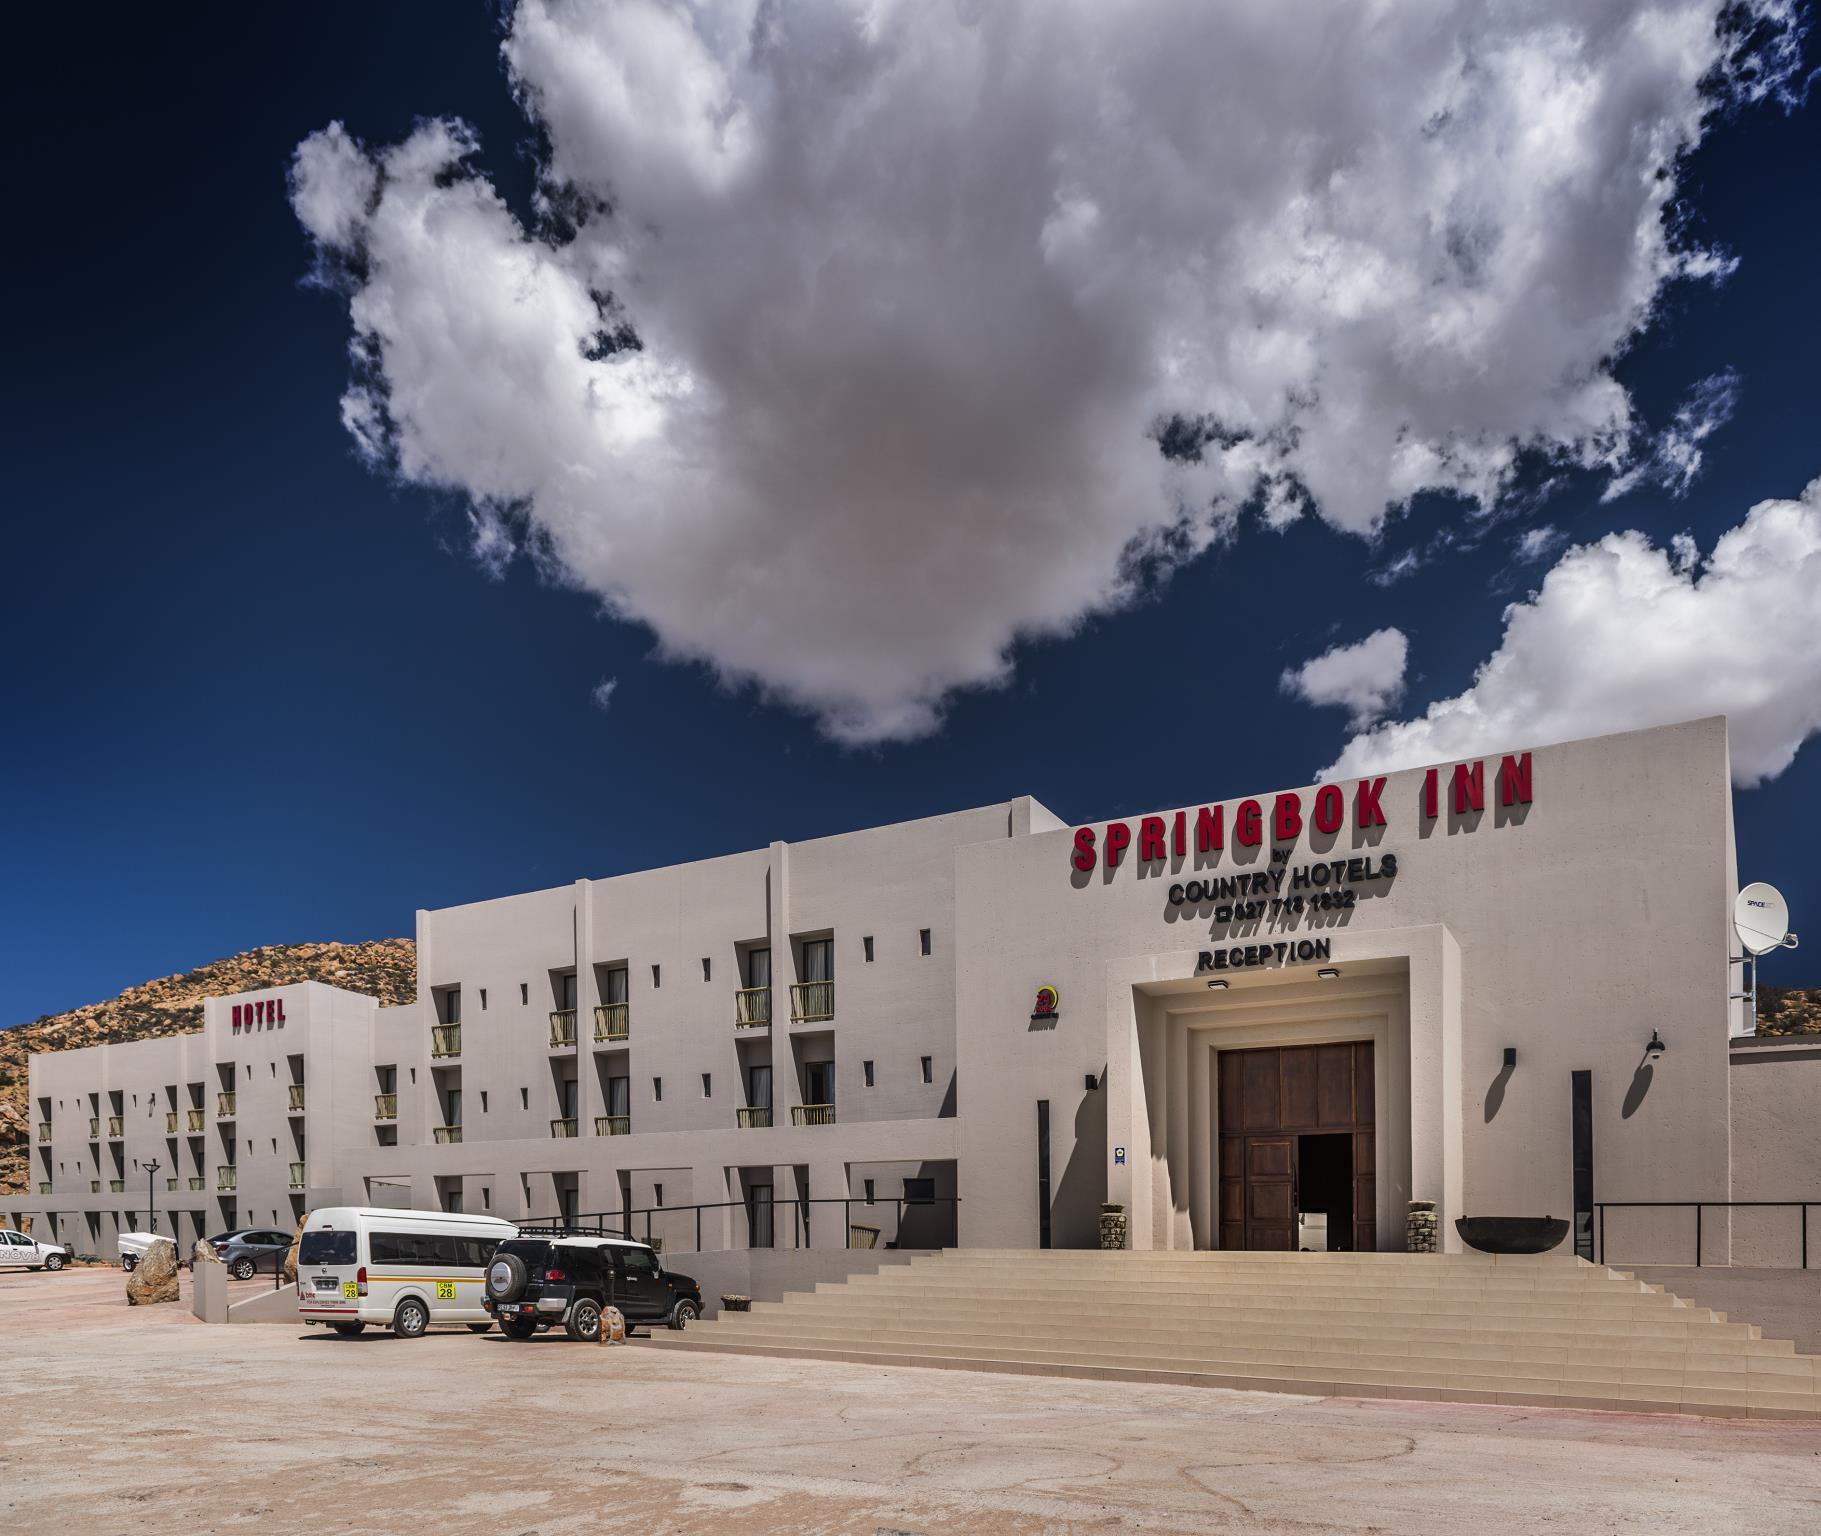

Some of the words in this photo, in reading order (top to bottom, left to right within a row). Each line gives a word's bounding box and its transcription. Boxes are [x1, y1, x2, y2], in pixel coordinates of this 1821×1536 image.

[1073, 776, 1388, 873] SPRINGBOK
[1425, 752, 1533, 819] INN
[1273, 849, 1291, 865] by
[1169, 869, 1286, 906] COUNTRY
[1293, 854, 1398, 889] HOTELS
[1198, 938, 1331, 971] RECEPTION
[232, 999, 286, 1028] HOTEL
[345, 1289, 356, 1298] 28
[439, 1288, 453, 1298] 28
